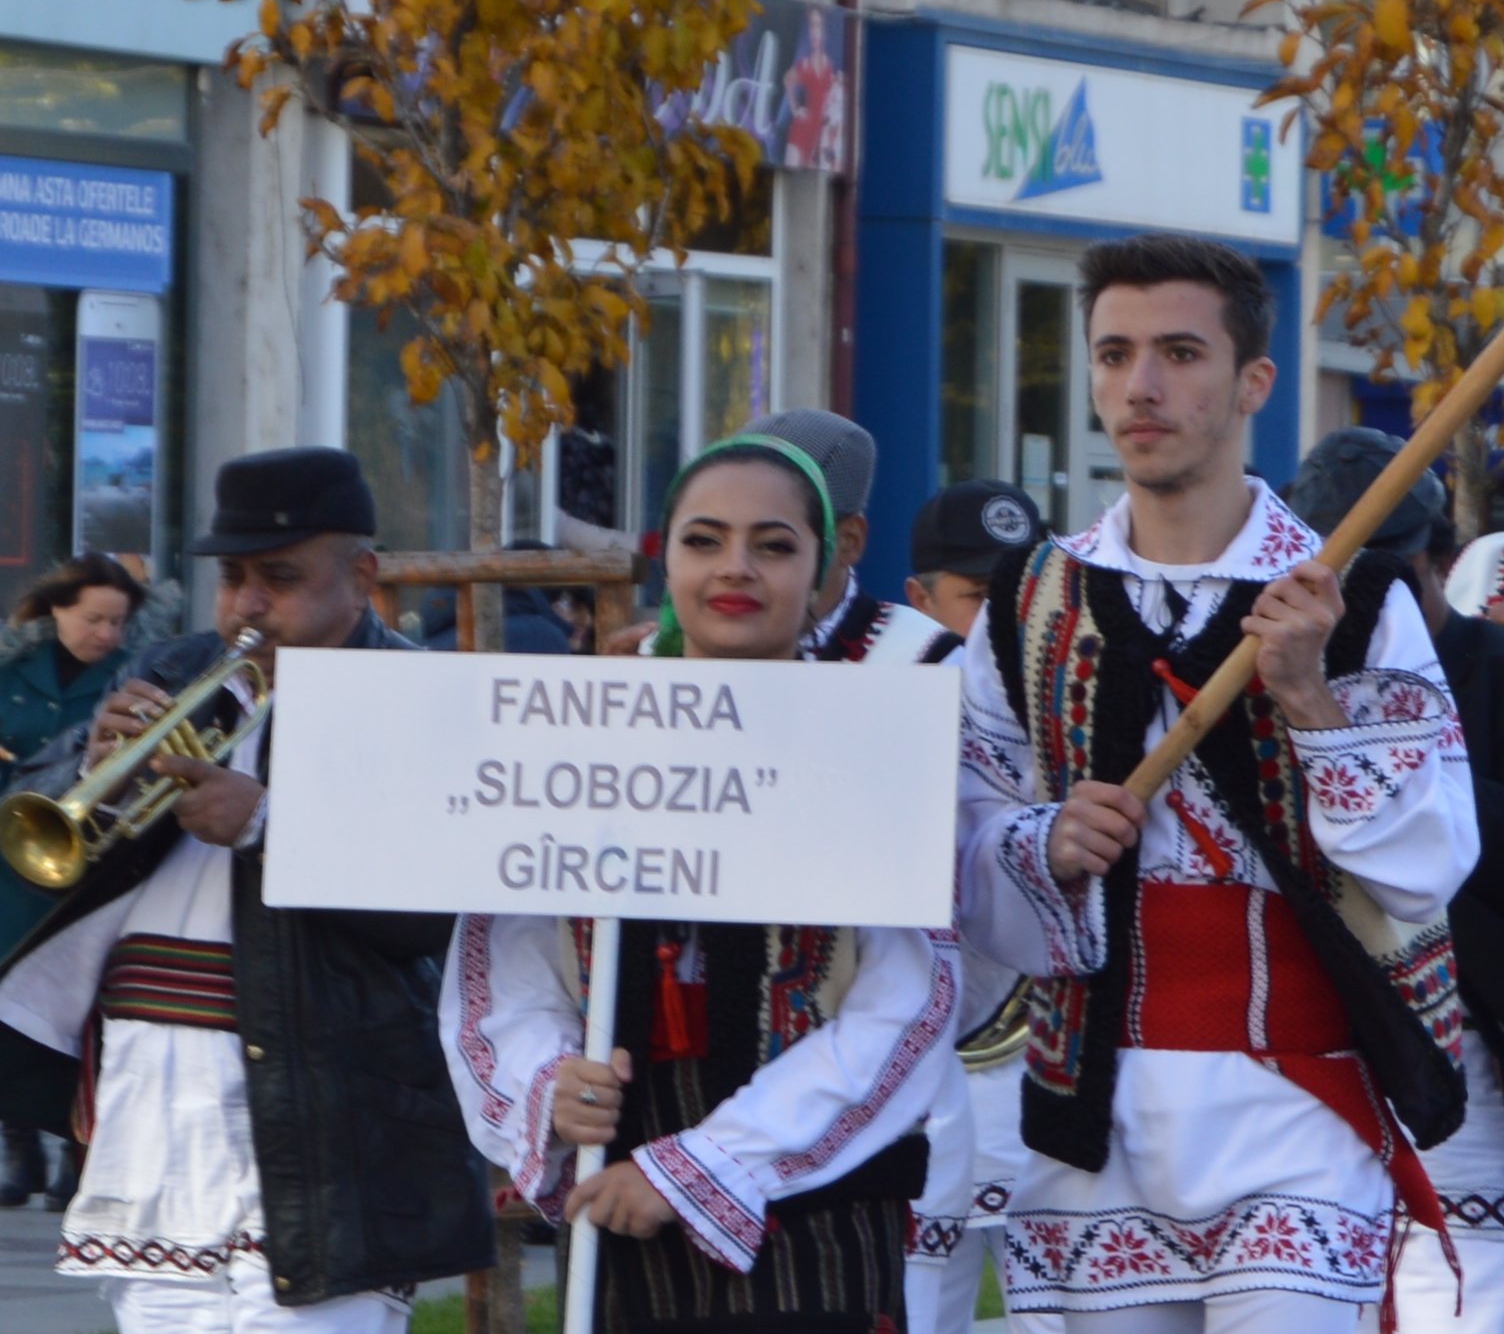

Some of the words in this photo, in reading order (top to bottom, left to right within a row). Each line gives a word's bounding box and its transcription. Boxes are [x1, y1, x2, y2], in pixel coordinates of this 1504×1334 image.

[981, 80, 1052, 184] SENSI
[31, 175, 74, 208] ASTA
[78, 180, 154, 215] OFERTELE
[55, 218, 76, 246] LA
[78, 219, 164, 253] GERMANOS
[490, 677, 744, 732] FANFARA
[446, 758, 779, 816] „SLOBOZIA”
[497, 831, 721, 897] GÎRCENI
